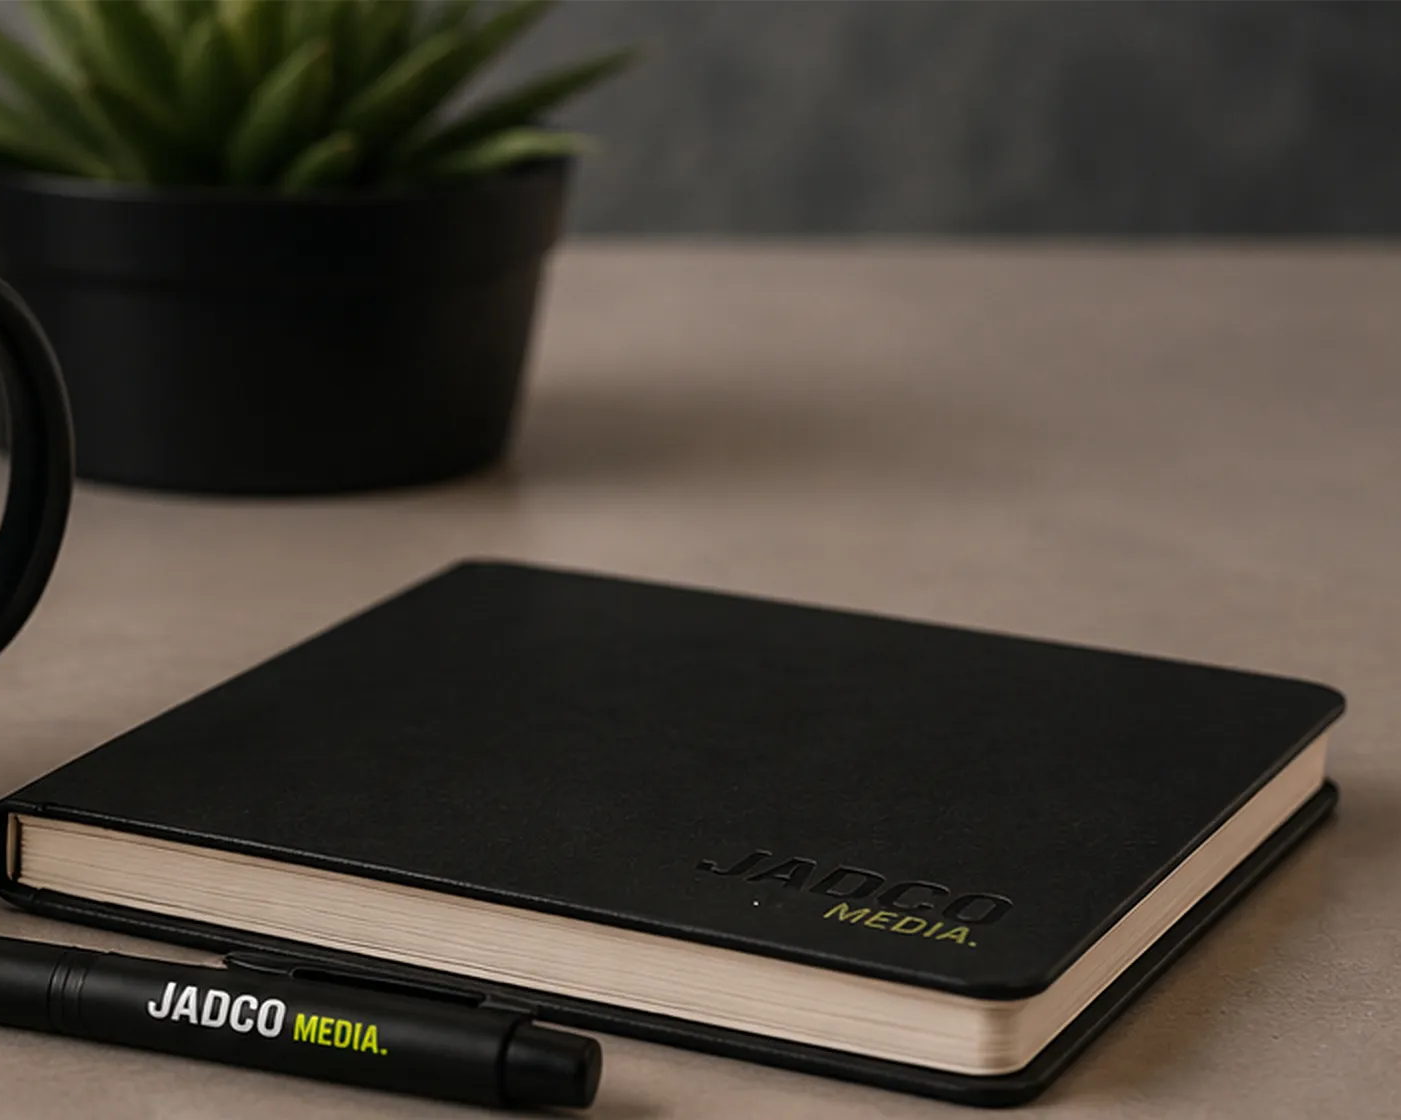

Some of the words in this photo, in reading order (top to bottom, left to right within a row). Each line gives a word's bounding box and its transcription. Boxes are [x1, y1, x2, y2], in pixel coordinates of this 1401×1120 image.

[698, 849, 1014, 925] JADCO
[823, 902, 977, 947] MEDIA.
[148, 982, 286, 1038] JADCO
[293, 1013, 388, 1055] MEDIA.
